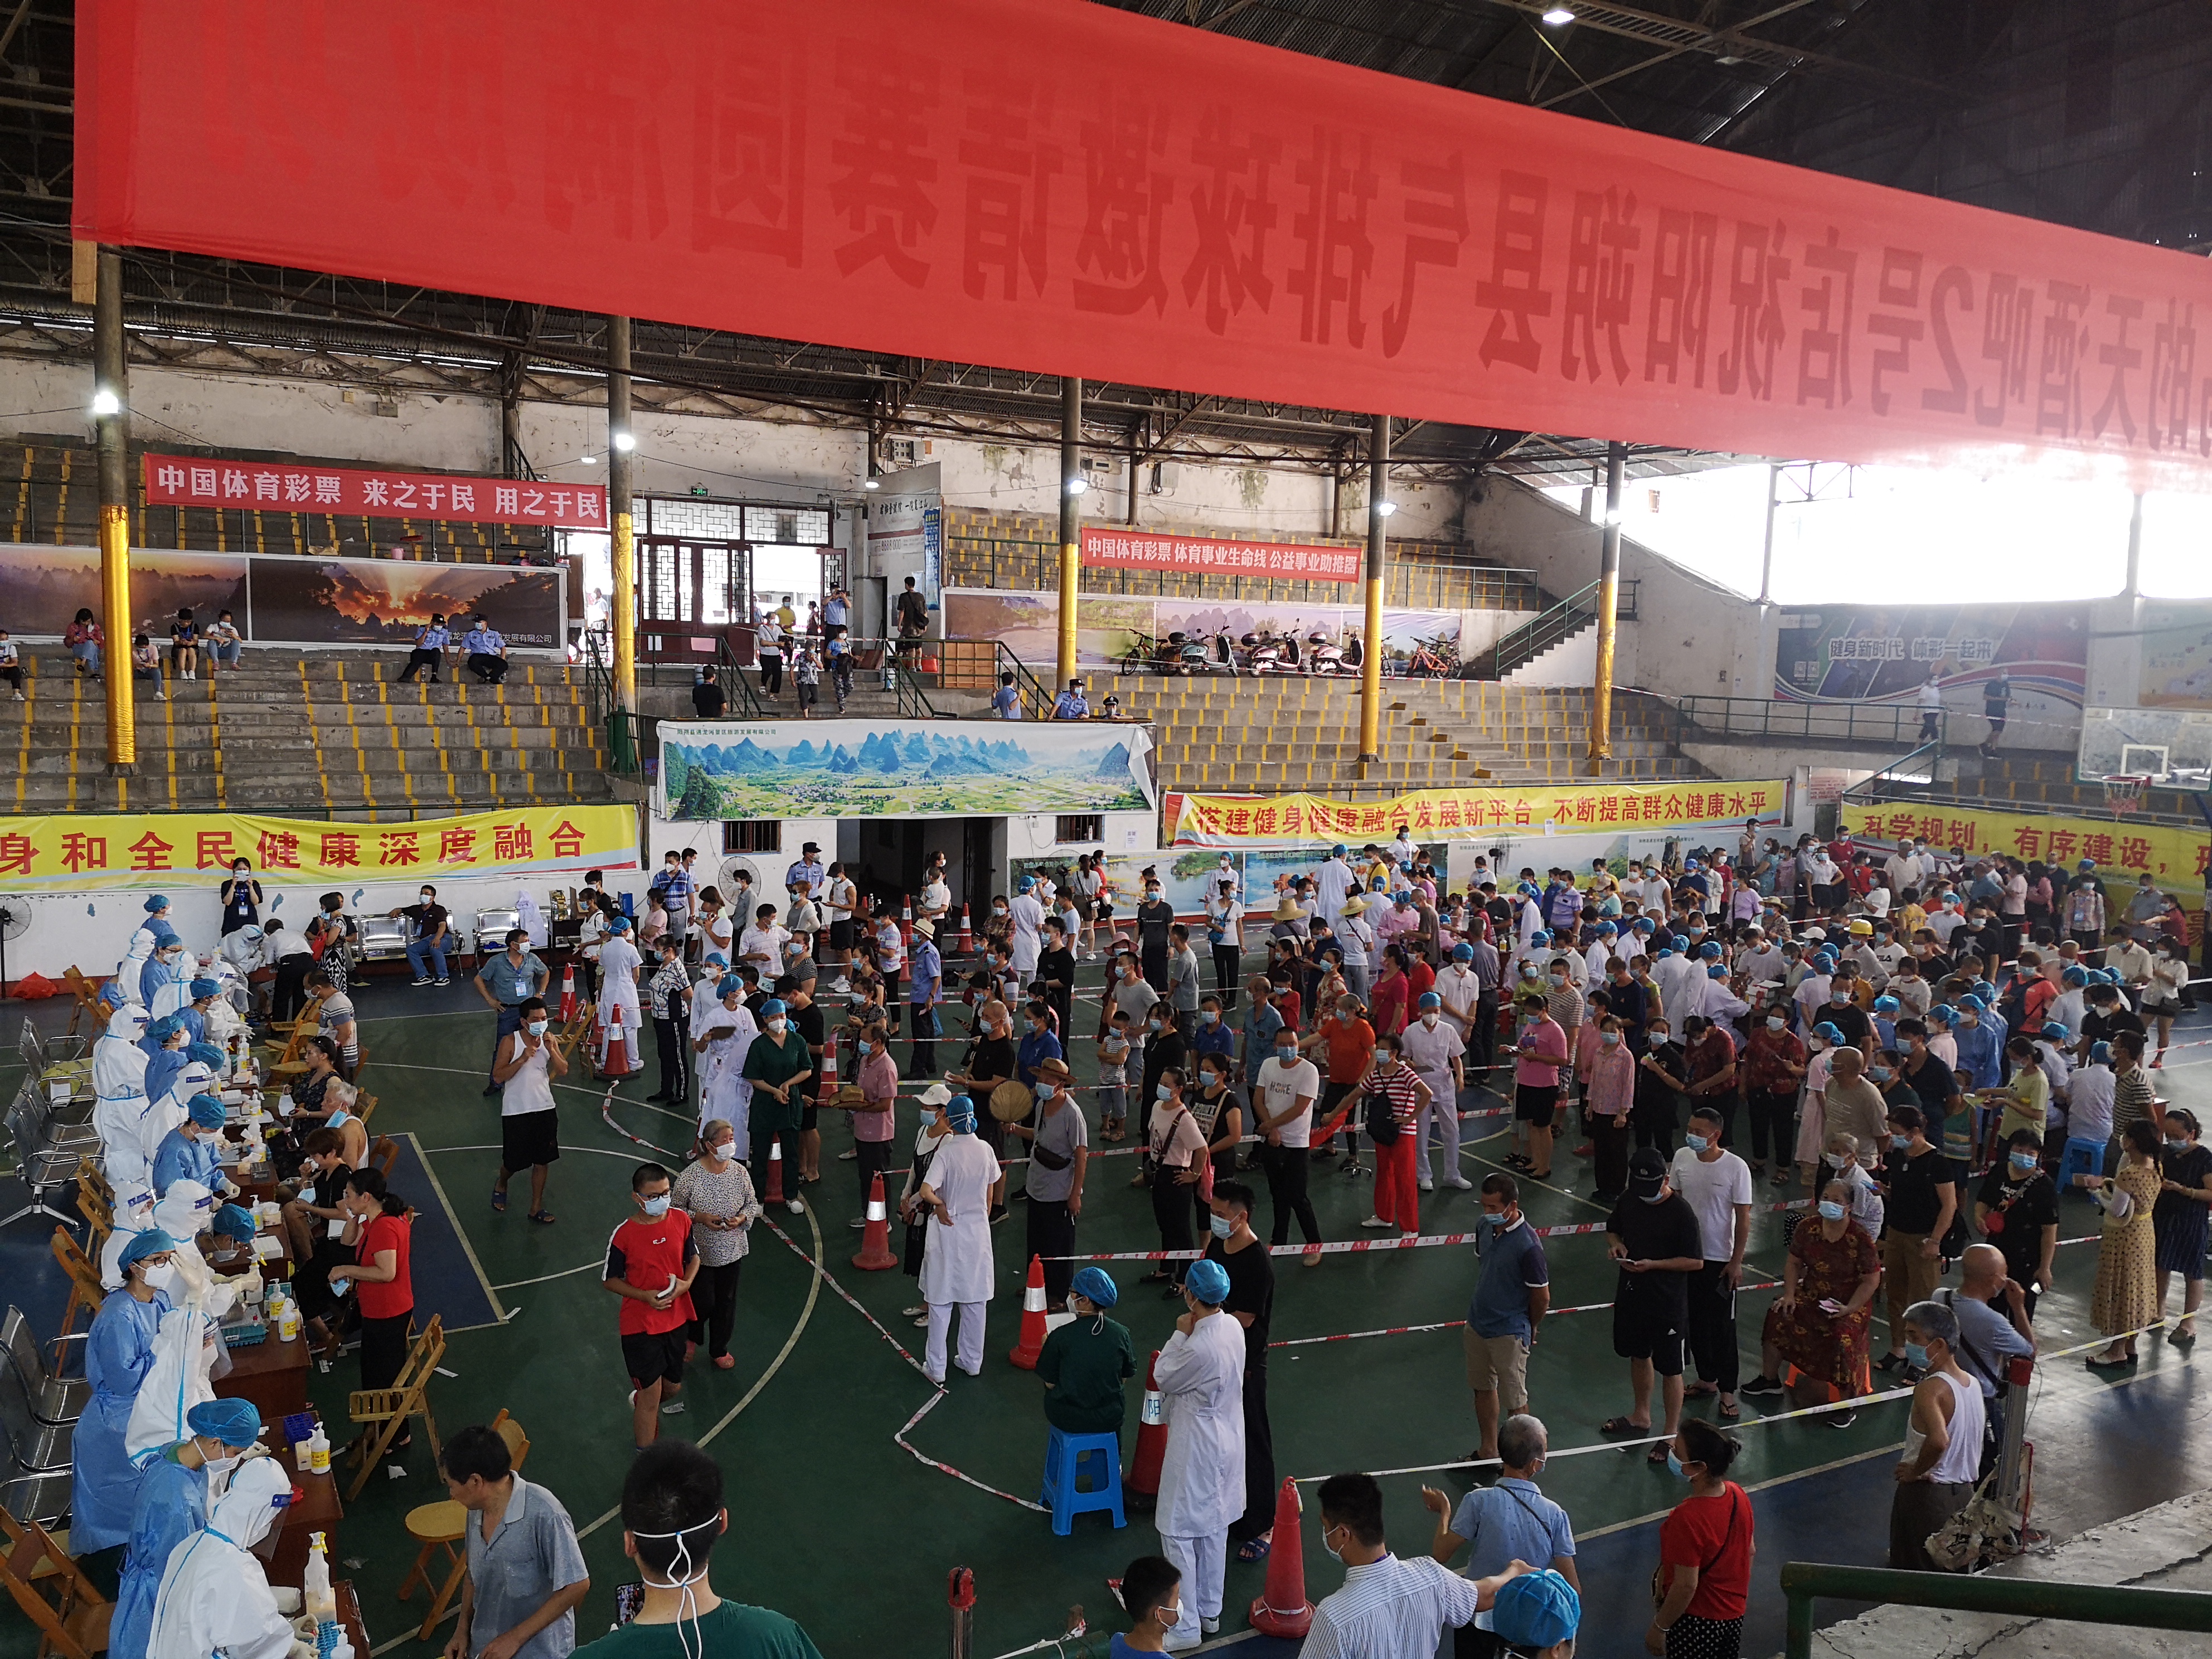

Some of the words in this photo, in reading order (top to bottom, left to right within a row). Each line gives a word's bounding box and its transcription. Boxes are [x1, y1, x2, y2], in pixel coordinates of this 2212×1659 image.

[158, 465, 341, 504] 中国体育彩票
[363, 479, 474, 512] 来之于民
[495, 487, 599, 519] 用之于民
[1088, 536, 1172, 562] 中国体育彩票
[1174, 542, 1267, 569] 体育事业生命线
[1269, 550, 1358, 575] 公益事业助推器
[1830, 639, 1904, 659] 健身新时代
[1912, 639, 1992, 659] 体彩一起来
[1197, 795, 1531, 836] 搭建健身健康融合发展新平台
[1554, 792, 1767, 824] 不断提高群众健康水平
[0, 821, 586, 875] 身和全民健康深度融合
[1148, 1398, 1163, 1418] 阳
